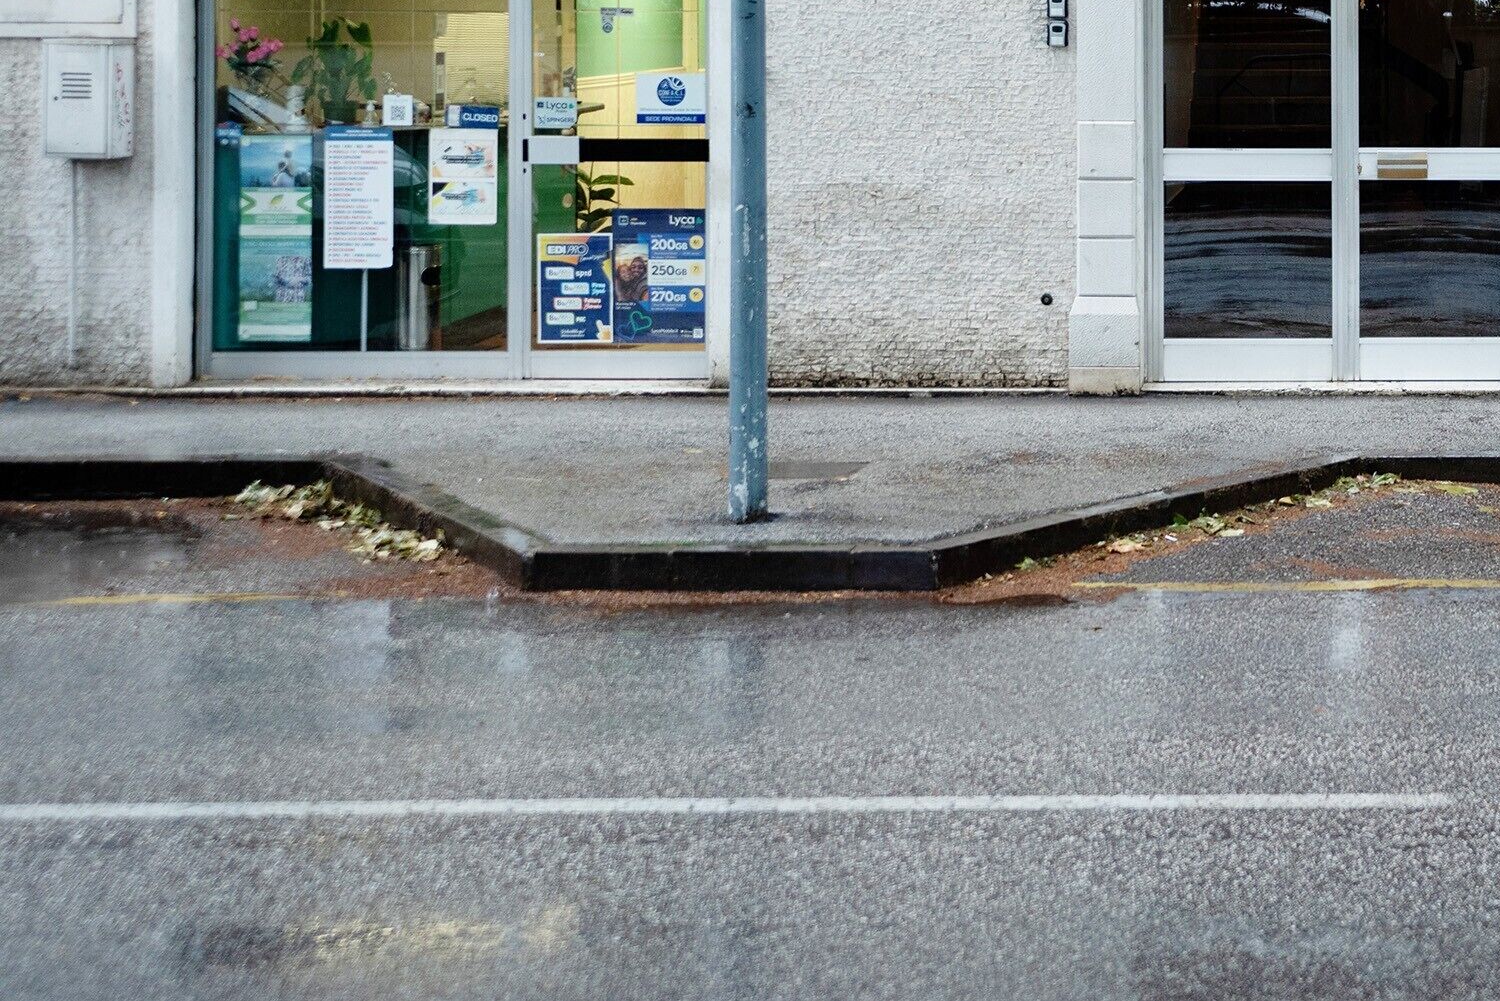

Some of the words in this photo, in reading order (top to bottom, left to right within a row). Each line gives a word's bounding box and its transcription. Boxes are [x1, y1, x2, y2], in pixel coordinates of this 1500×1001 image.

[546, 101, 568, 111] Lyca
[462, 112, 498, 122] CLOSED
[669, 214, 695, 227] Lyca
[651, 238, 688, 251] 200GB
[651, 265, 688, 276] 250GB
[651, 290, 687, 302] 270GB
